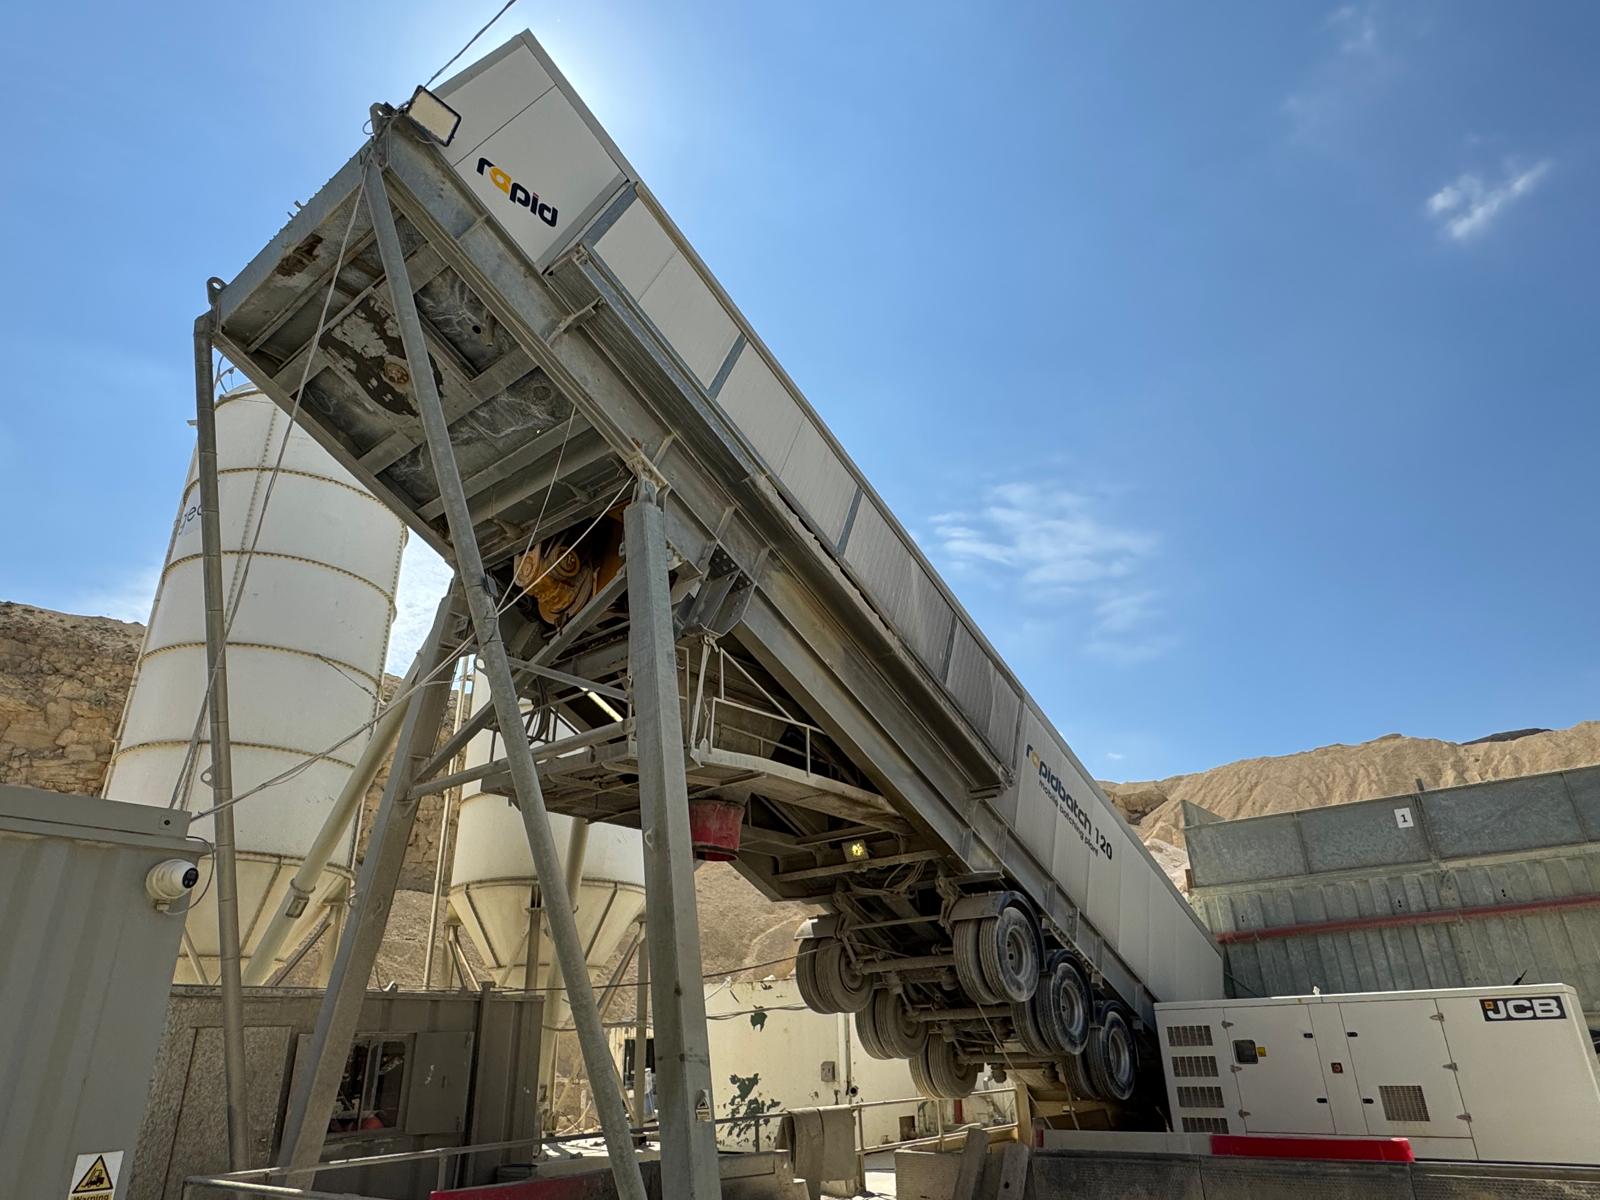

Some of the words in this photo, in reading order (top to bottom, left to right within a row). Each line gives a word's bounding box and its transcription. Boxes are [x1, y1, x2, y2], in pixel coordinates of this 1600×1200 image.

[476, 157, 559, 227] rapid
[1026, 744, 1092, 834] rapidbatch
[1095, 827, 1113, 860] 120
[1400, 814, 1408, 823] 1
[1059, 804, 1084, 841] batching
[1485, 998, 1561, 1019] JCB
